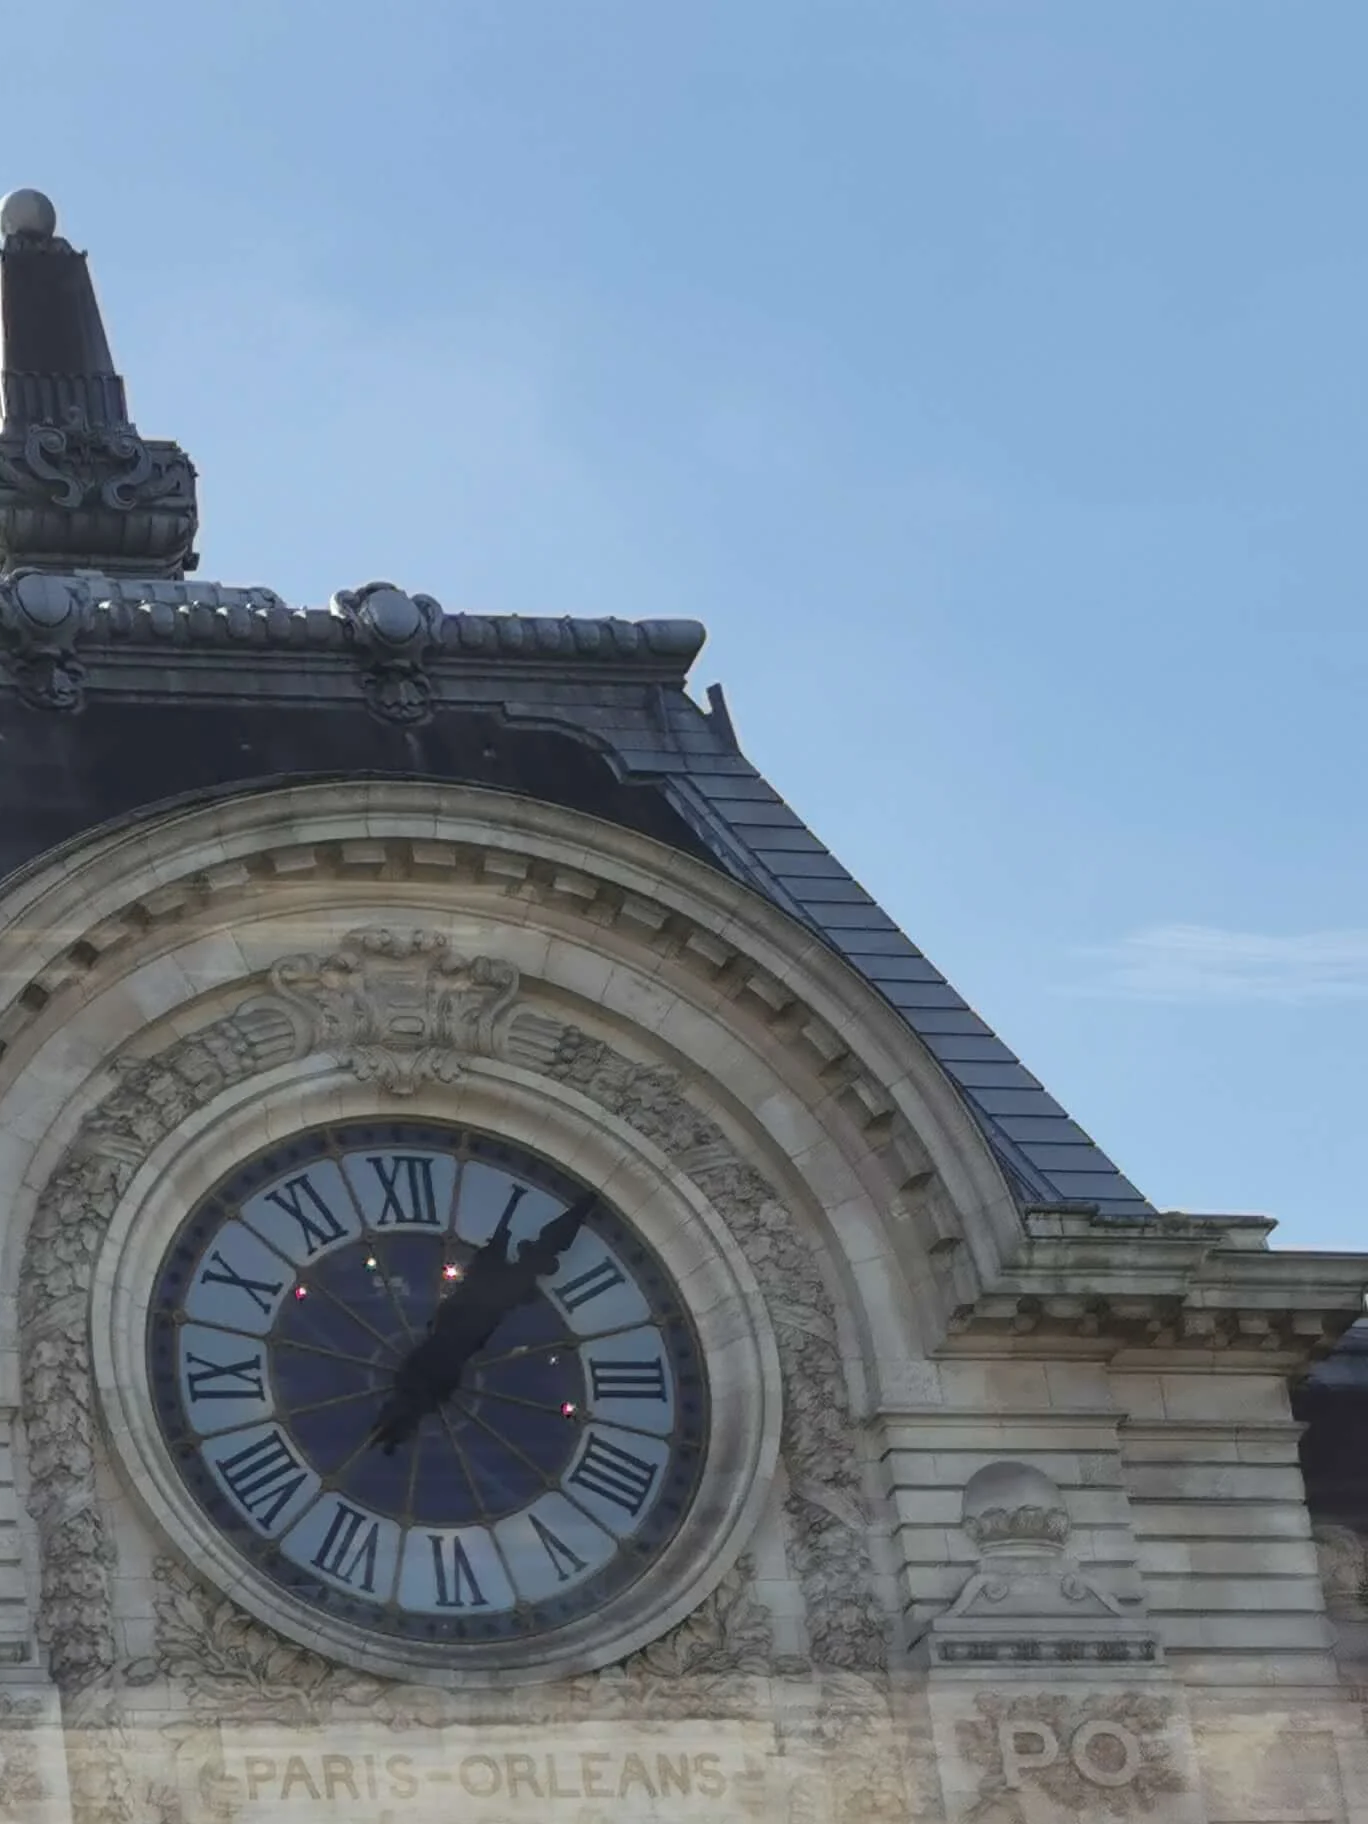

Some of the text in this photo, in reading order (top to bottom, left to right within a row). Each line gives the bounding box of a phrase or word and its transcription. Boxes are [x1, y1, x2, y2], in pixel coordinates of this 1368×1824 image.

[265, 1174, 348, 1254] XI
[366, 1156, 441, 1226] XII
[201, 1250, 283, 1314] X
[552, 1256, 626, 1314] II
[186, 1352, 266, 1402] IX
[589, 1356, 668, 1402] III
[215, 1430, 309, 1531] VIII
[568, 1432, 658, 1516] IIII
[310, 1501, 380, 1593] VII
[427, 1534, 489, 1607] VI
[528, 1513, 588, 1581] V
